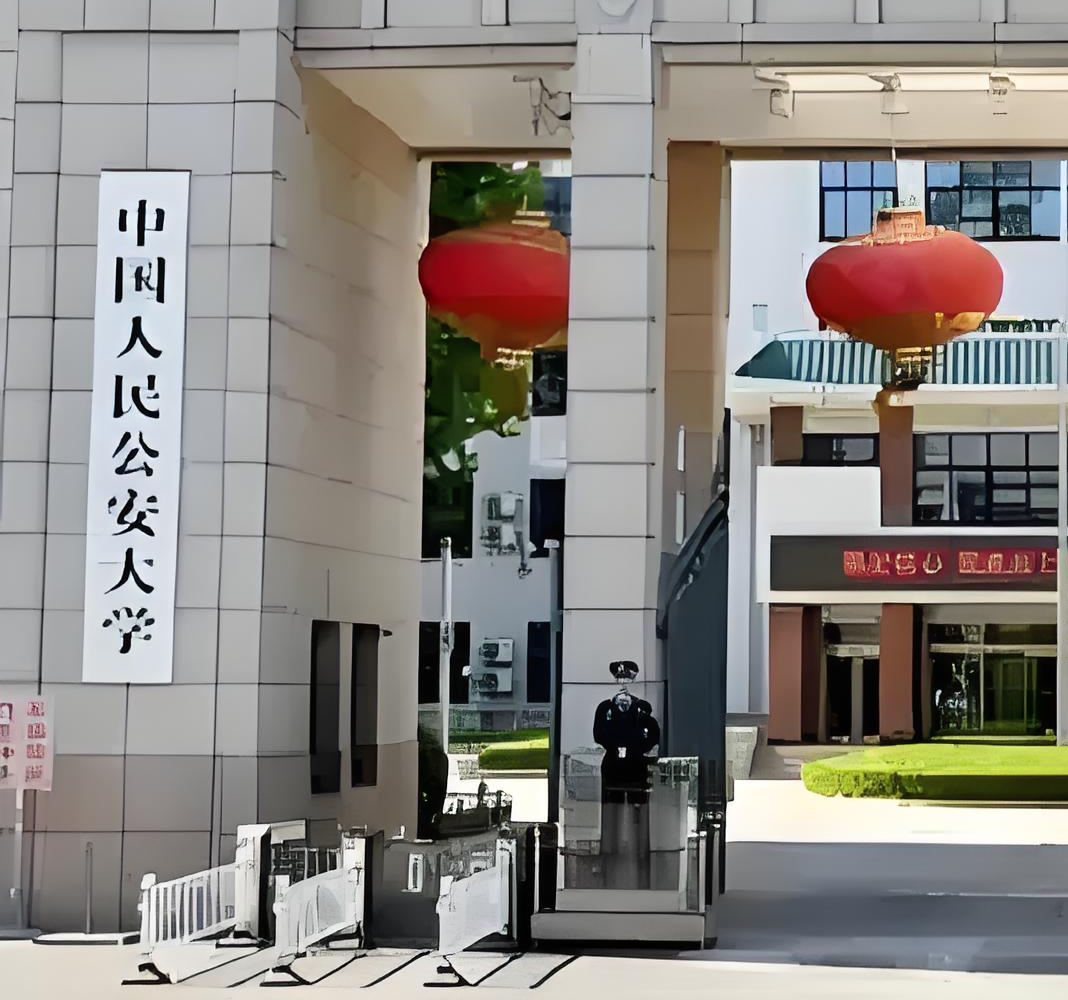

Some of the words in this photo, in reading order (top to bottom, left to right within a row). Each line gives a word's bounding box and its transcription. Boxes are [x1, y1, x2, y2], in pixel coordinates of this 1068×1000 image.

[102, 199, 166, 655] 中国人民公安大学
